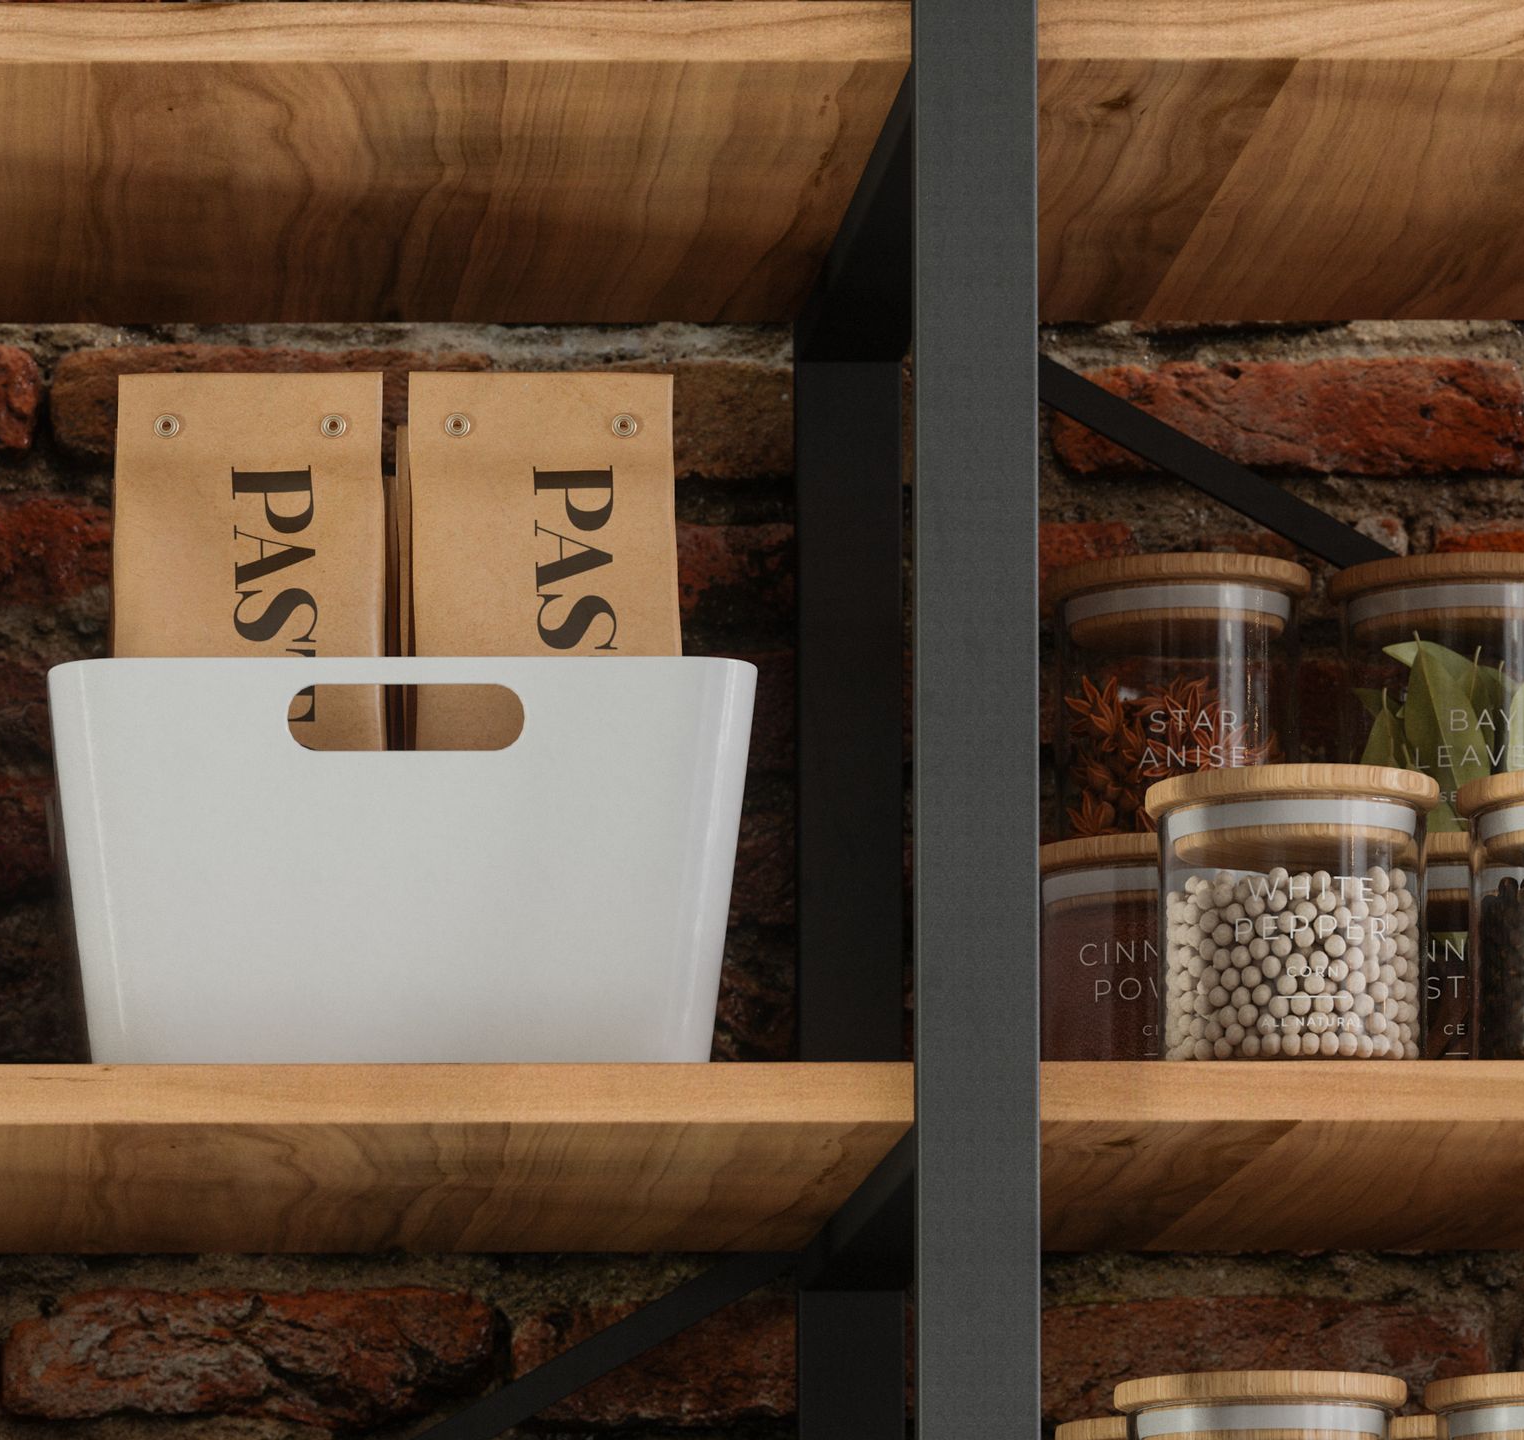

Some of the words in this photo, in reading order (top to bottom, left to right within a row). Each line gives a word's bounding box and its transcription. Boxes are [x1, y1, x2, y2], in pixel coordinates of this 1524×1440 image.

[532, 465, 618, 650] PAS
[1150, 709, 1239, 734] STAR
[1448, 708, 1517, 733] BAY
[1138, 745, 1248, 769] ANISE
[1247, 876, 1374, 902] WHITE
[1235, 914, 1387, 941] PEPPER
[1286, 965, 1339, 977] CORN
